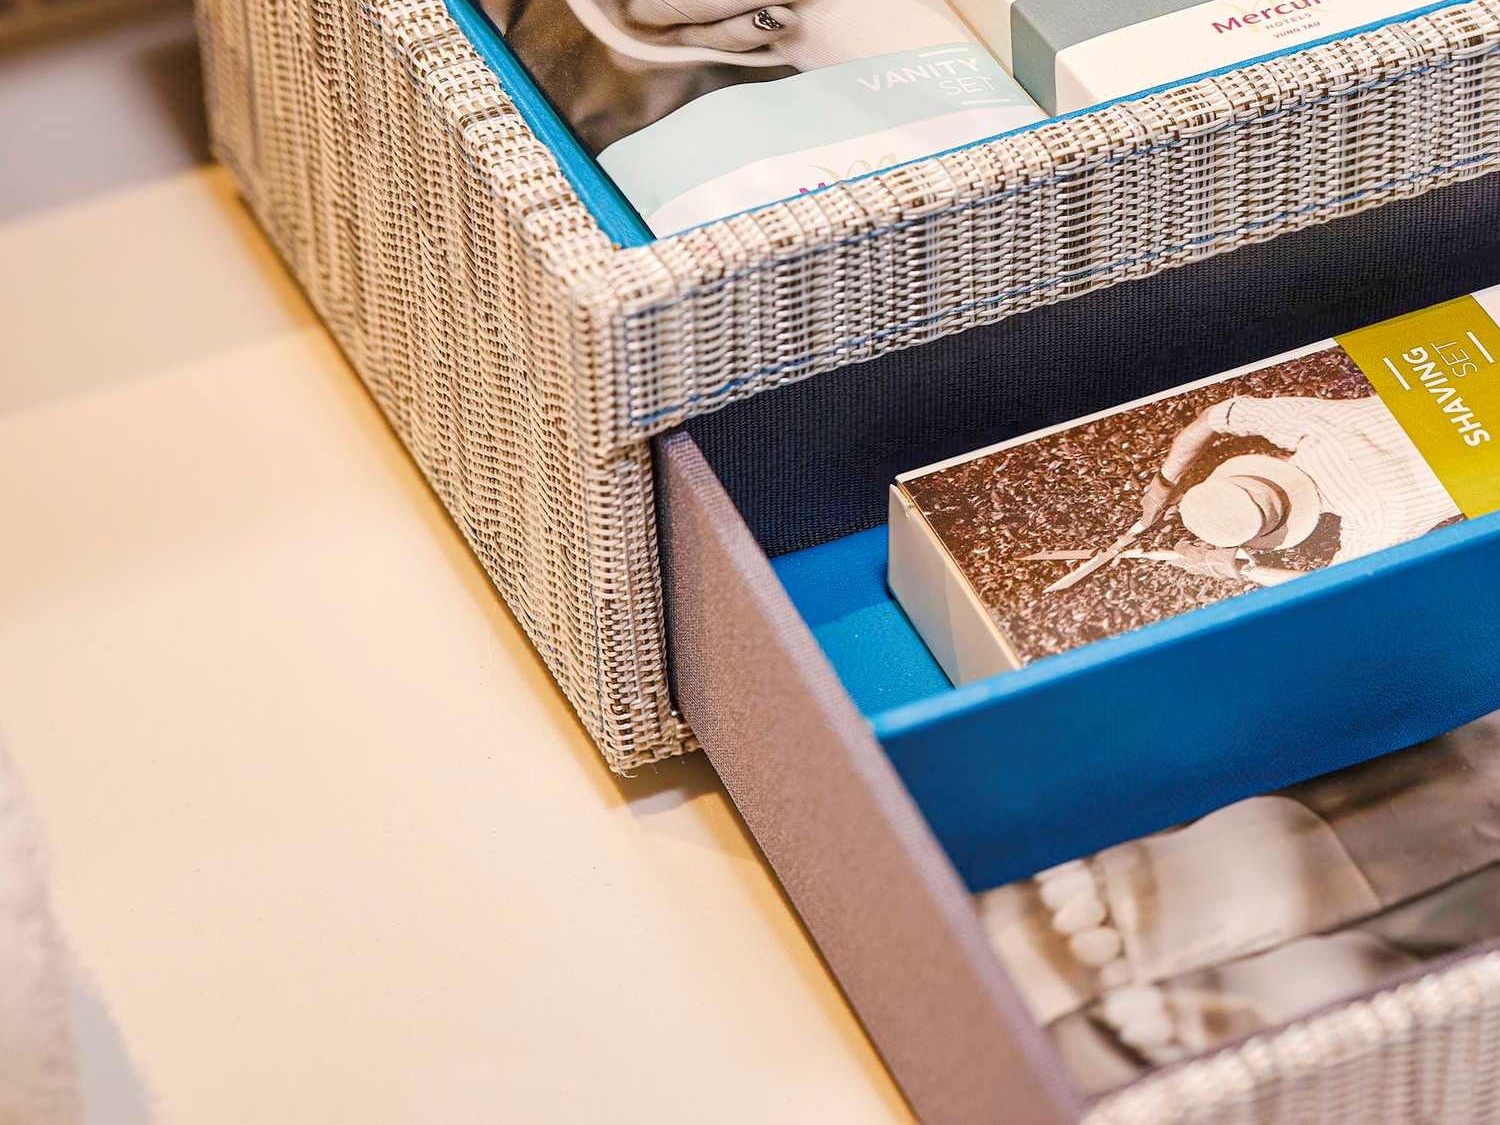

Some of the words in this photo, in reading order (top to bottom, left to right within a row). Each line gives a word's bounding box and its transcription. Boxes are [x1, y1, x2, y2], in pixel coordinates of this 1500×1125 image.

[1265, 12, 1312, 30] HOTELS
[856, 57, 980, 92] VANITY
[939, 76, 995, 96] SET
[1431, 341, 1478, 378] SET
[1402, 346, 1491, 447] SHAVING
